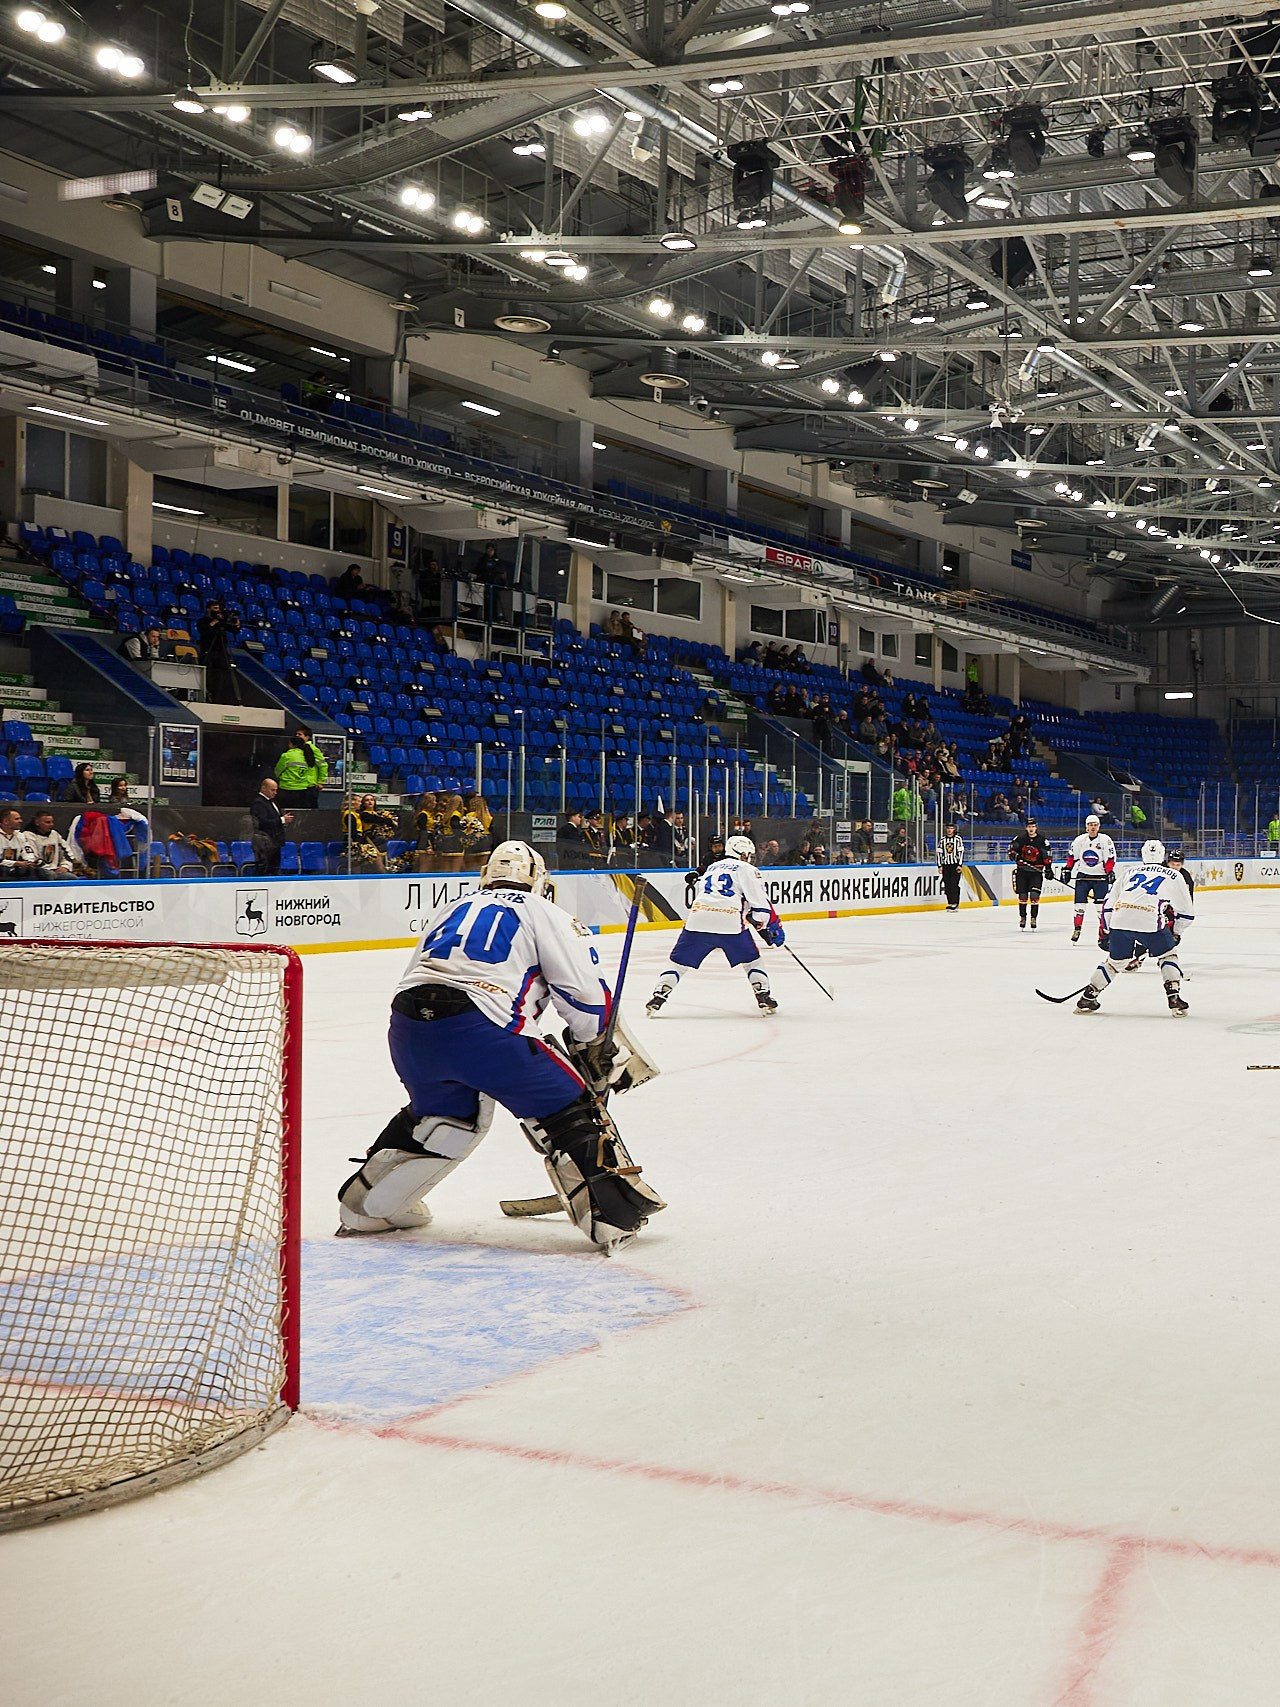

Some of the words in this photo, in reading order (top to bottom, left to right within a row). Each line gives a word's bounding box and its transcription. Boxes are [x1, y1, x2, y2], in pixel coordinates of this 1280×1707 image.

[171, 205, 179, 216] 8
[457, 313, 463, 322] 7
[298, 425, 358, 450] ЧЕМПИОНАТ
[361, 444, 399, 461] РОССИИ
[401, 454, 414, 465] ПО
[416, 459, 451, 475] ХОККЕЮ
[465, 471, 530, 496] ВСЕРОССИЙСКАЯ
[533, 489, 575, 508] ХОККЕЙНАЯ
[393, 530, 402, 547] 9
[776, 553, 811, 571] SPAR
[20, 712, 56, 723] SYNERGETIC
[48, 736, 83, 746] SYNERGETIC
[533, 817, 556, 826] PARI
[704, 873, 735, 898] 13
[820, 871, 909, 902] ХОККЕЙНАЯ
[275, 895, 330, 911] НИЖНИЙ
[404, 882, 478, 909] ЛИГ
[32, 900, 155, 916] ПРАВИТЕЛЬСТВО
[32, 916, 144, 933] НИЖЕГОРОДСКОЙ
[275, 913, 341, 927] НОВГОРОД
[422, 901, 520, 964] 40
